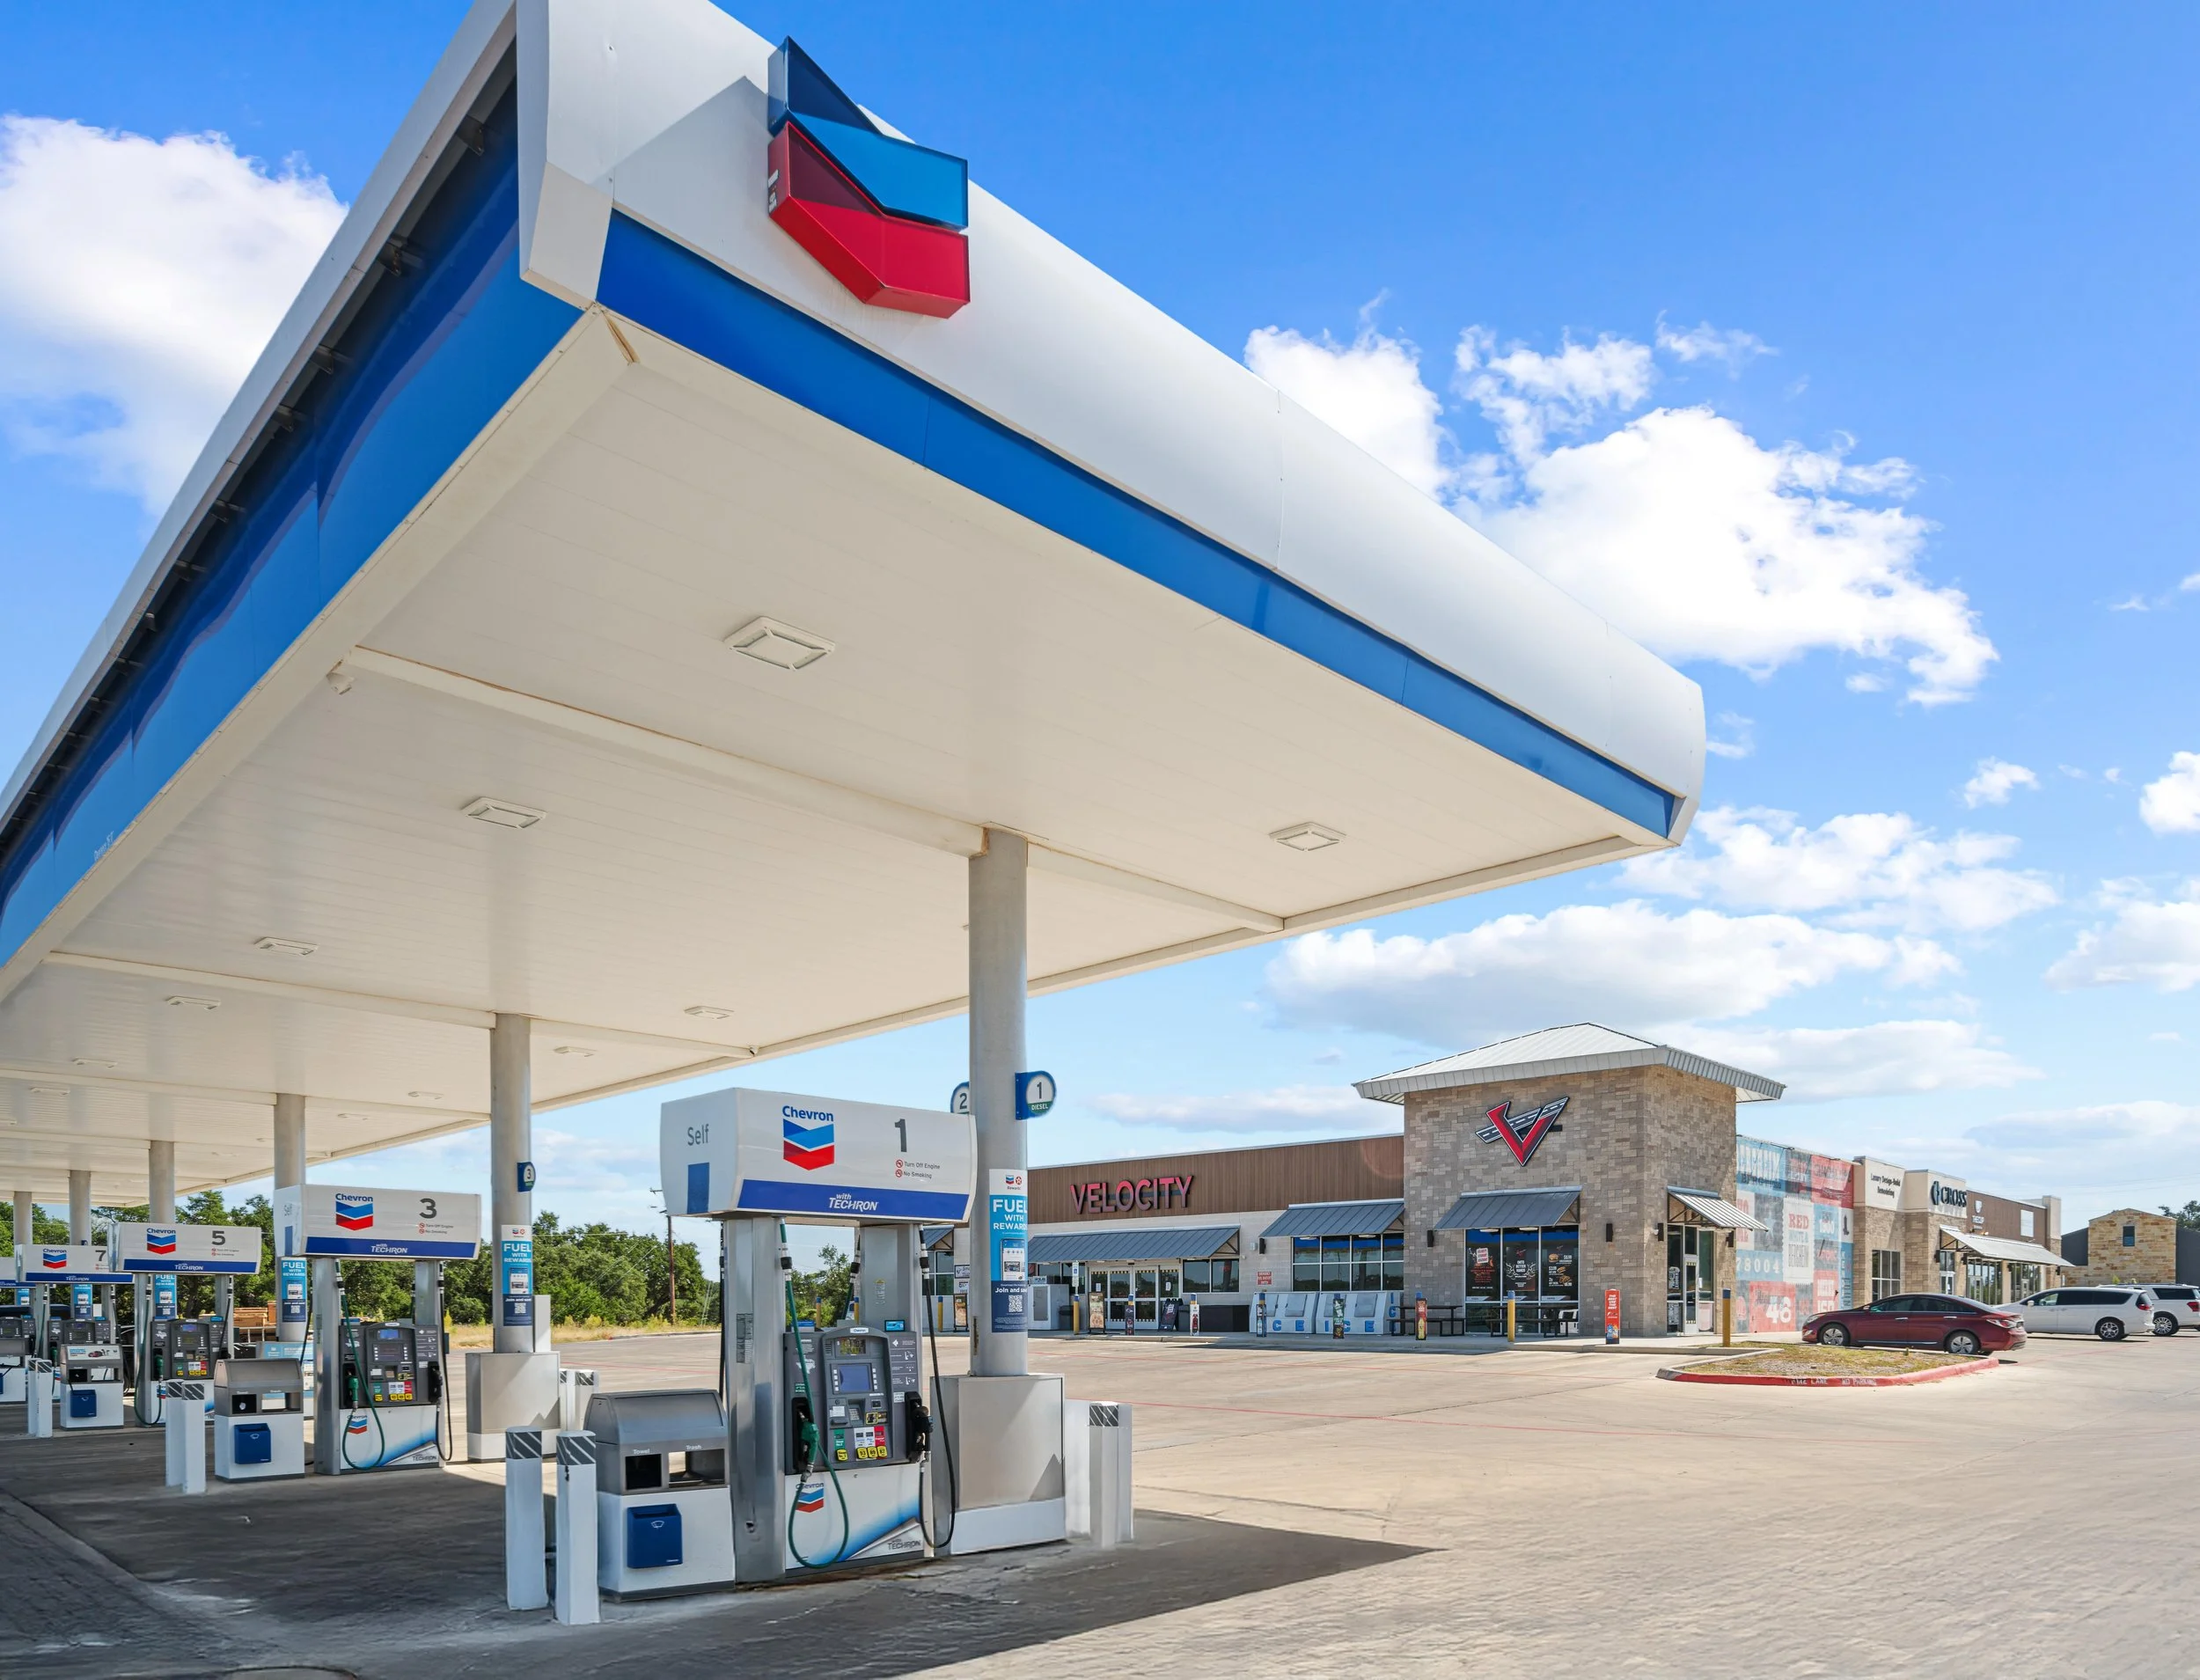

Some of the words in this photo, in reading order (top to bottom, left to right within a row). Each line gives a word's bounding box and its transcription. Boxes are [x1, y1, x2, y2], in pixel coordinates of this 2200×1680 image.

[1037, 1082, 1042, 1099] 1
[959, 1093, 967, 1109] 2
[782, 1105, 834, 1121] Chevron
[687, 1124, 709, 1146] Self
[895, 1119, 907, 1152] 1
[527, 1169, 531, 1179] 3
[335, 1193, 373, 1202] Chevron
[1070, 1176, 1193, 1214] VELOCITY
[1940, 1186, 1967, 1207] CROSS
[419, 1198, 436, 1219] 3
[829, 1198, 878, 1212] TECHRON
[993, 1199, 1028, 1214] FUEL
[1788, 1214, 1808, 1229] RED
[212, 1230, 225, 1245] 5
[95, 1251, 106, 1262] 7
[370, 1245, 408, 1254] TECHRON
[1736, 1258, 1779, 1273] 78004
[1766, 1295, 1791, 1324] 46
[887, 1540, 920, 1550] TECHRON
